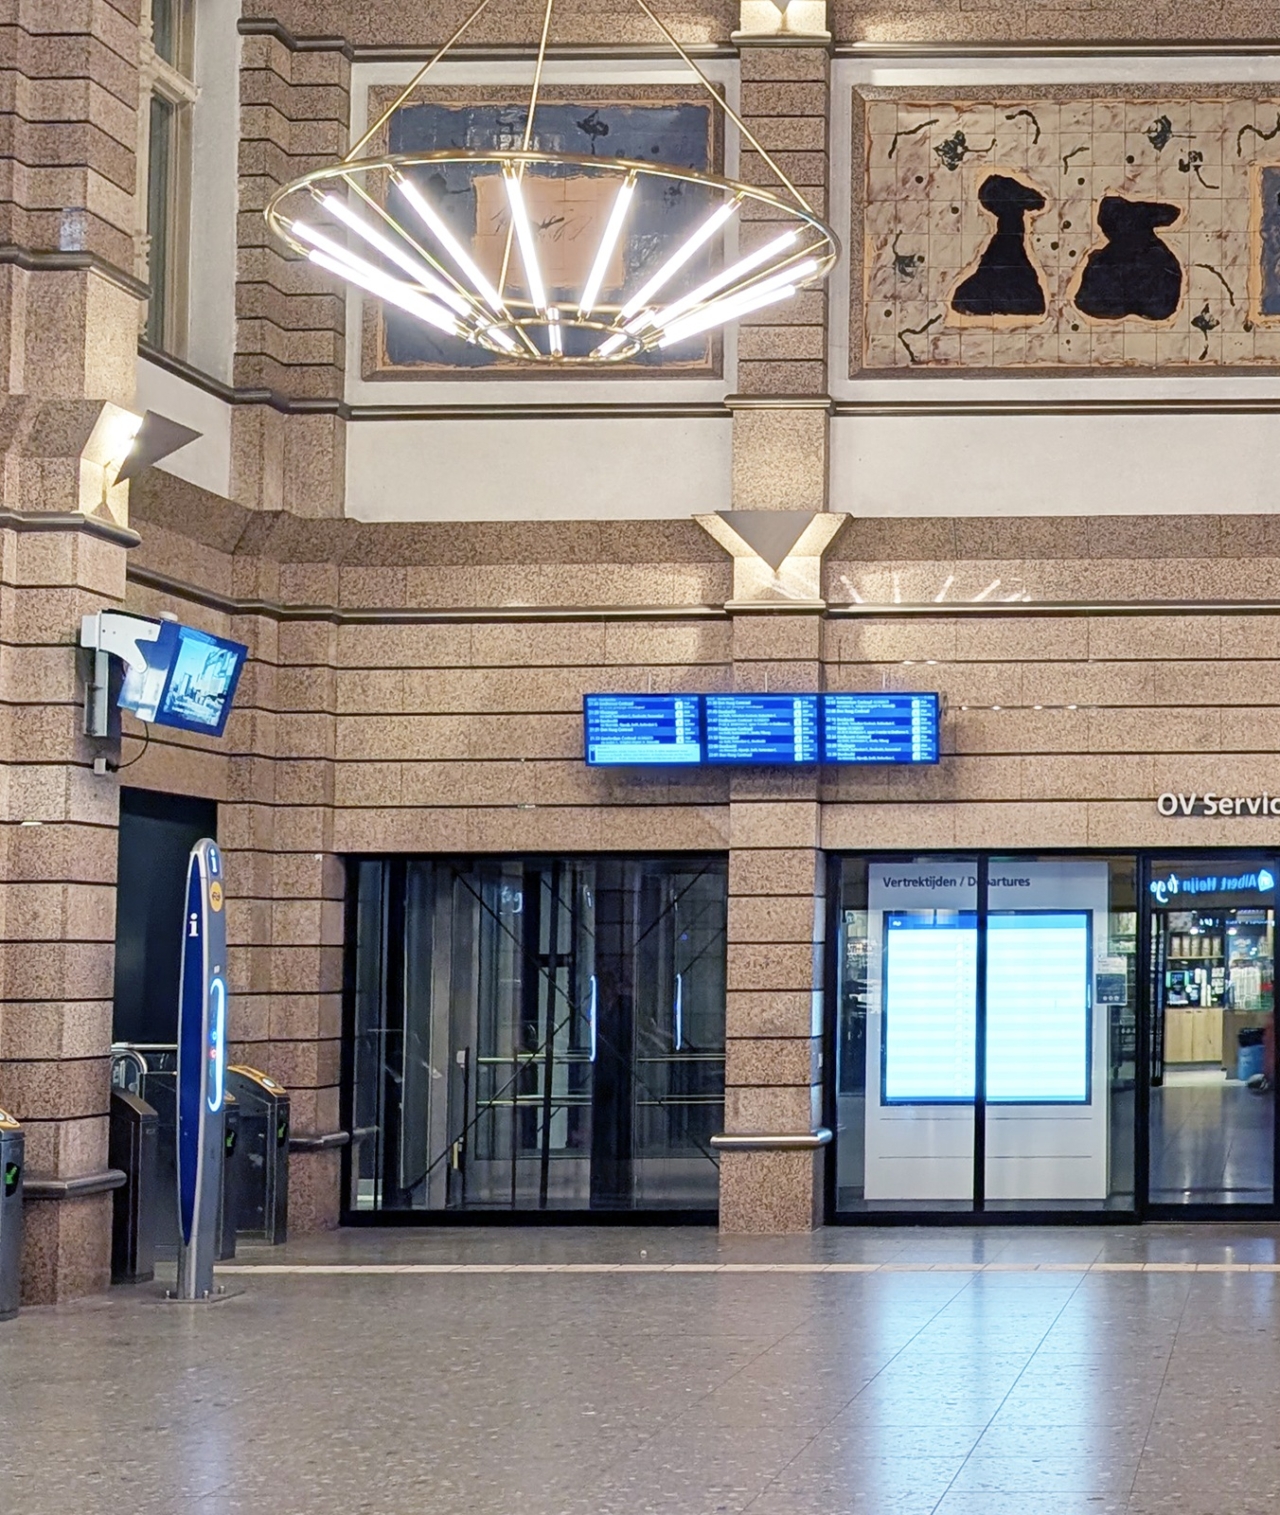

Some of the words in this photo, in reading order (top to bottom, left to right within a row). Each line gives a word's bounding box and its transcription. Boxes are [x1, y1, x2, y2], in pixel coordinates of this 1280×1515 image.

[1157, 793, 1195, 816] OV
[882, 876, 957, 889] Vertrektijden
[959, 876, 965, 887] /
[967, 876, 1031, 887] Dartures
